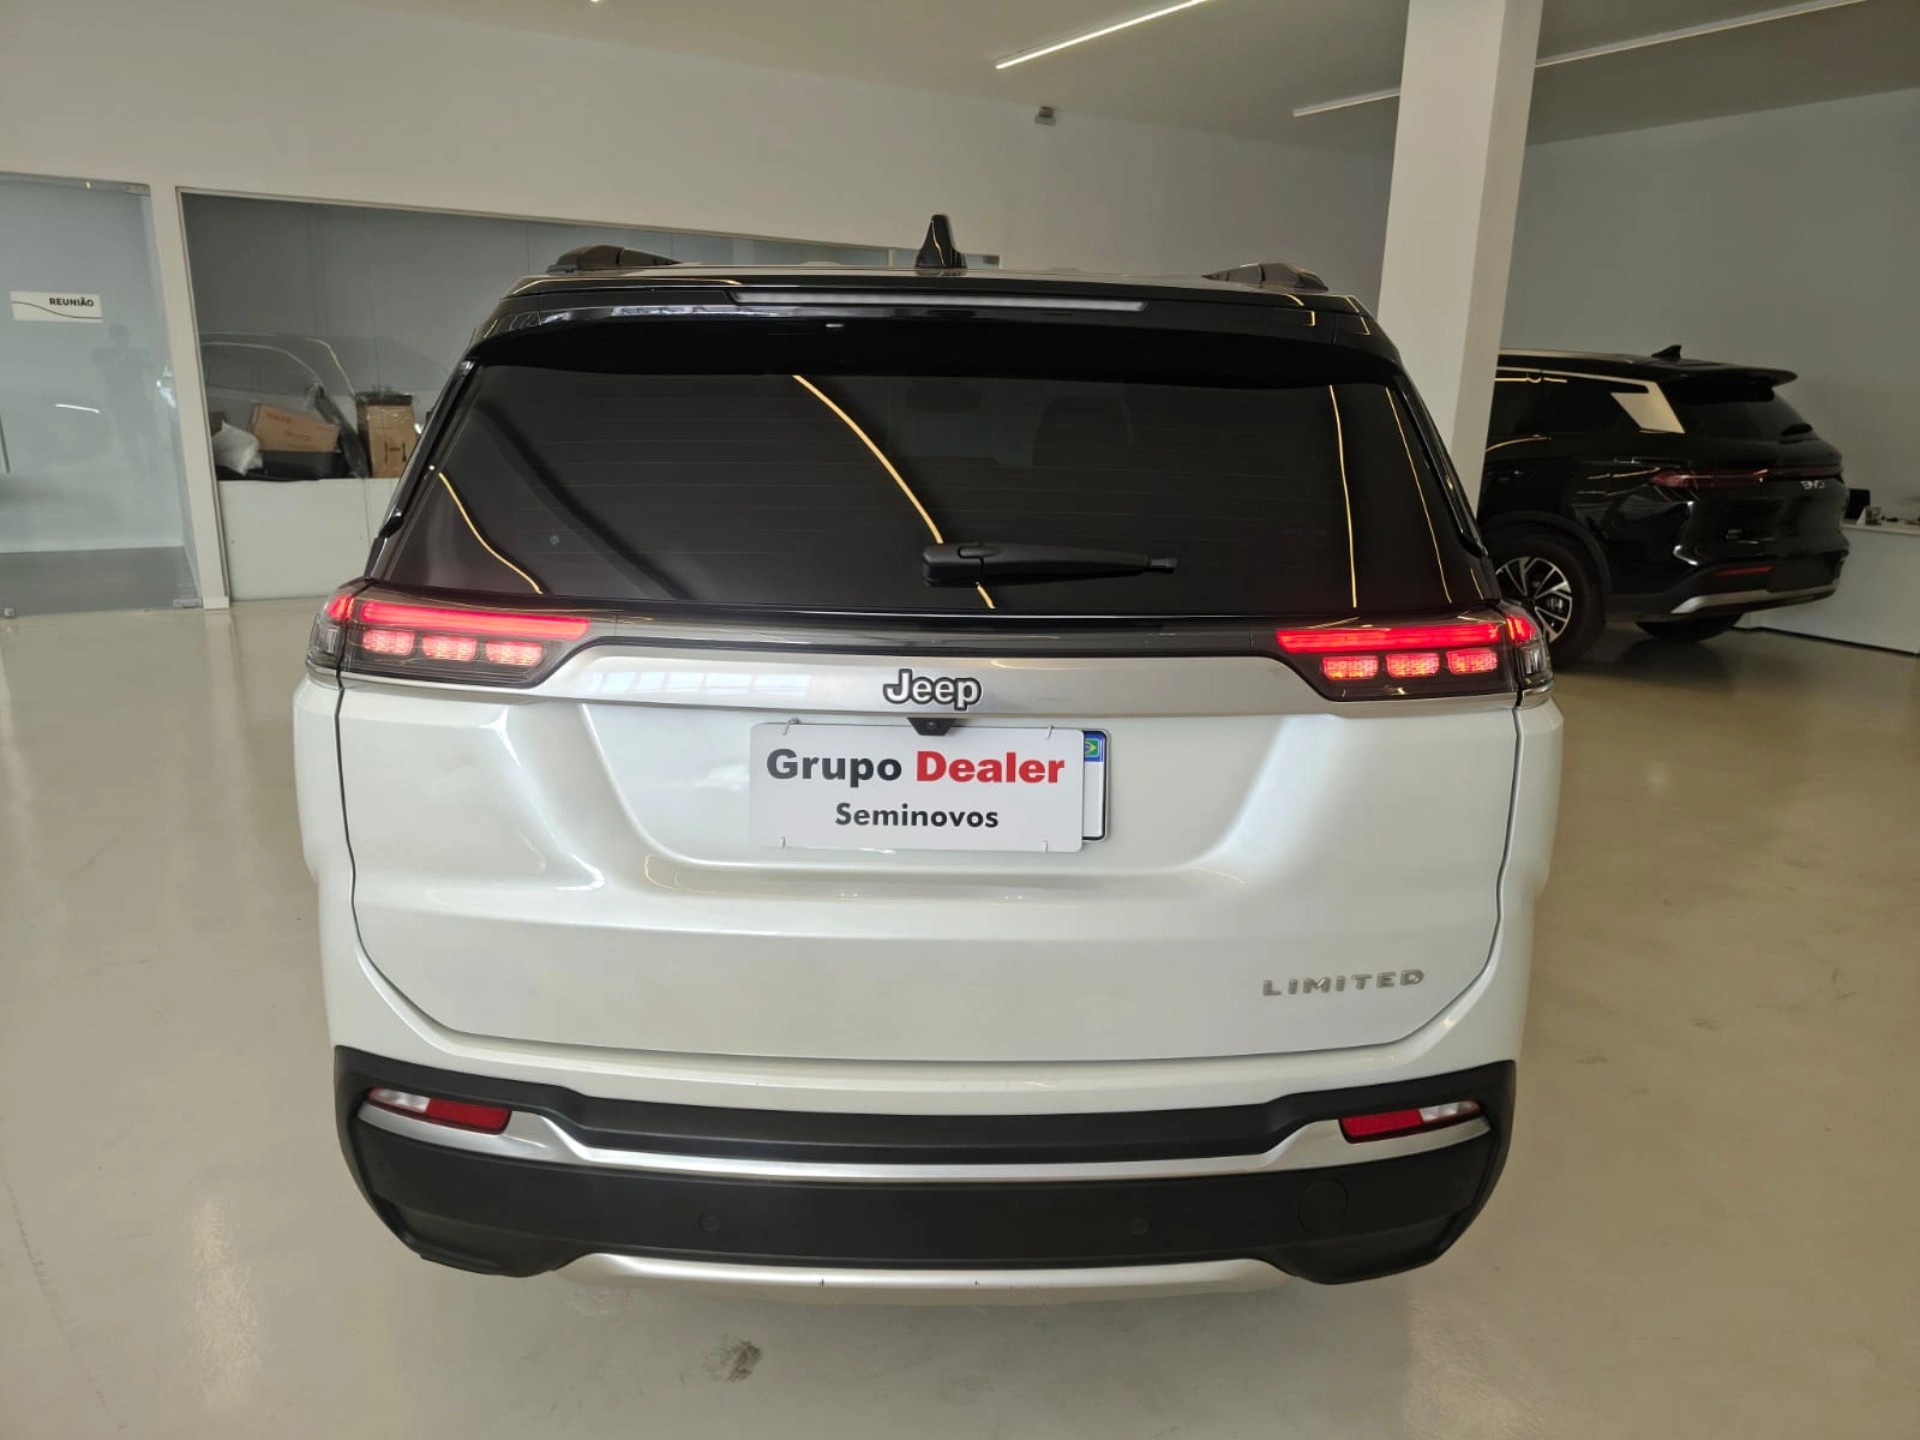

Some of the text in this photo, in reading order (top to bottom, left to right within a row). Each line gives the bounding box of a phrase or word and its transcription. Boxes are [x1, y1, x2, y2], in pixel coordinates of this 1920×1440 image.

[48, 297, 95, 307] REUNIÃO
[883, 668, 983, 711] Jeep
[766, 748, 1066, 788] Grupo Dealer
[834, 802, 999, 828] Seminovos
[1262, 969, 1425, 997] LIMITED
